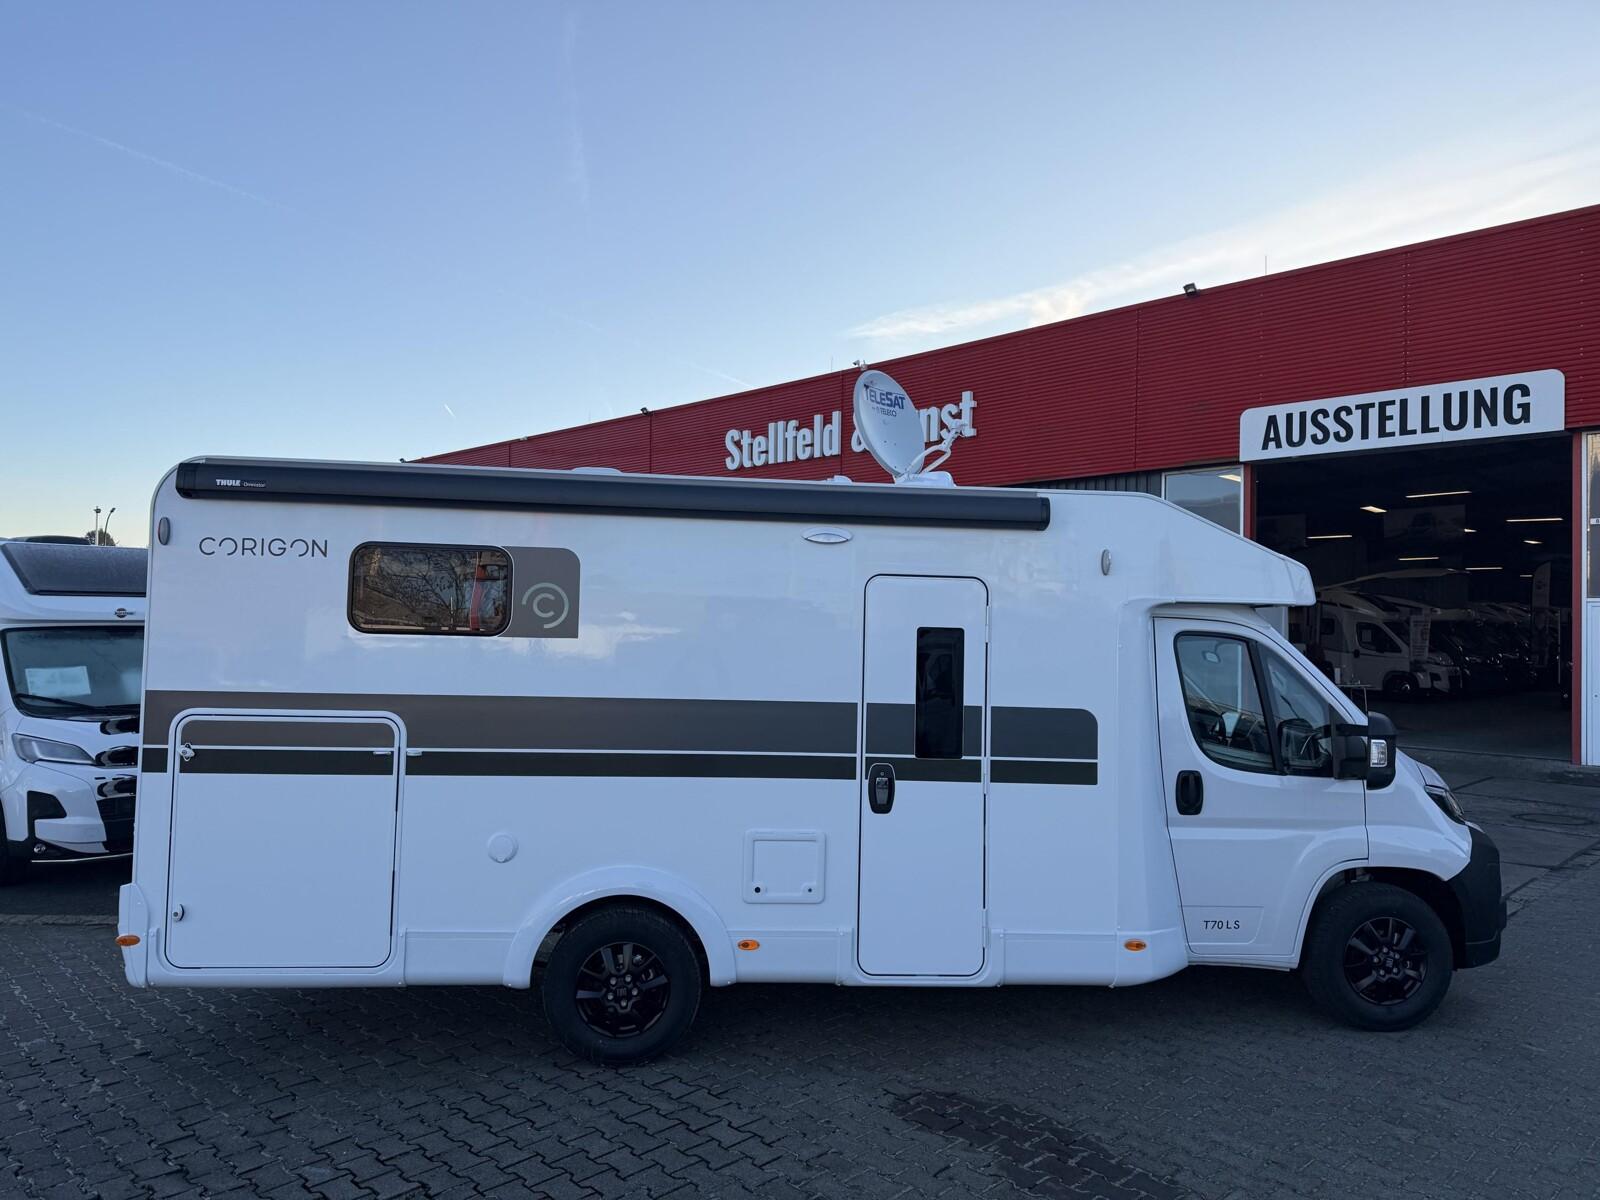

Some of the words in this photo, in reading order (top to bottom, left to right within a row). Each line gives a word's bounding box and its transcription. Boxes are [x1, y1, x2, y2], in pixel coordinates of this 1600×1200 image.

[863, 384, 905, 410] TELESAT
[1261, 383, 1531, 451] AUSSTELLUNG
[725, 410, 842, 470] Stellfeld
[215, 479, 241, 487] THULE
[199, 536, 328, 558] CORIGON
[1203, 920, 1224, 930] T70
